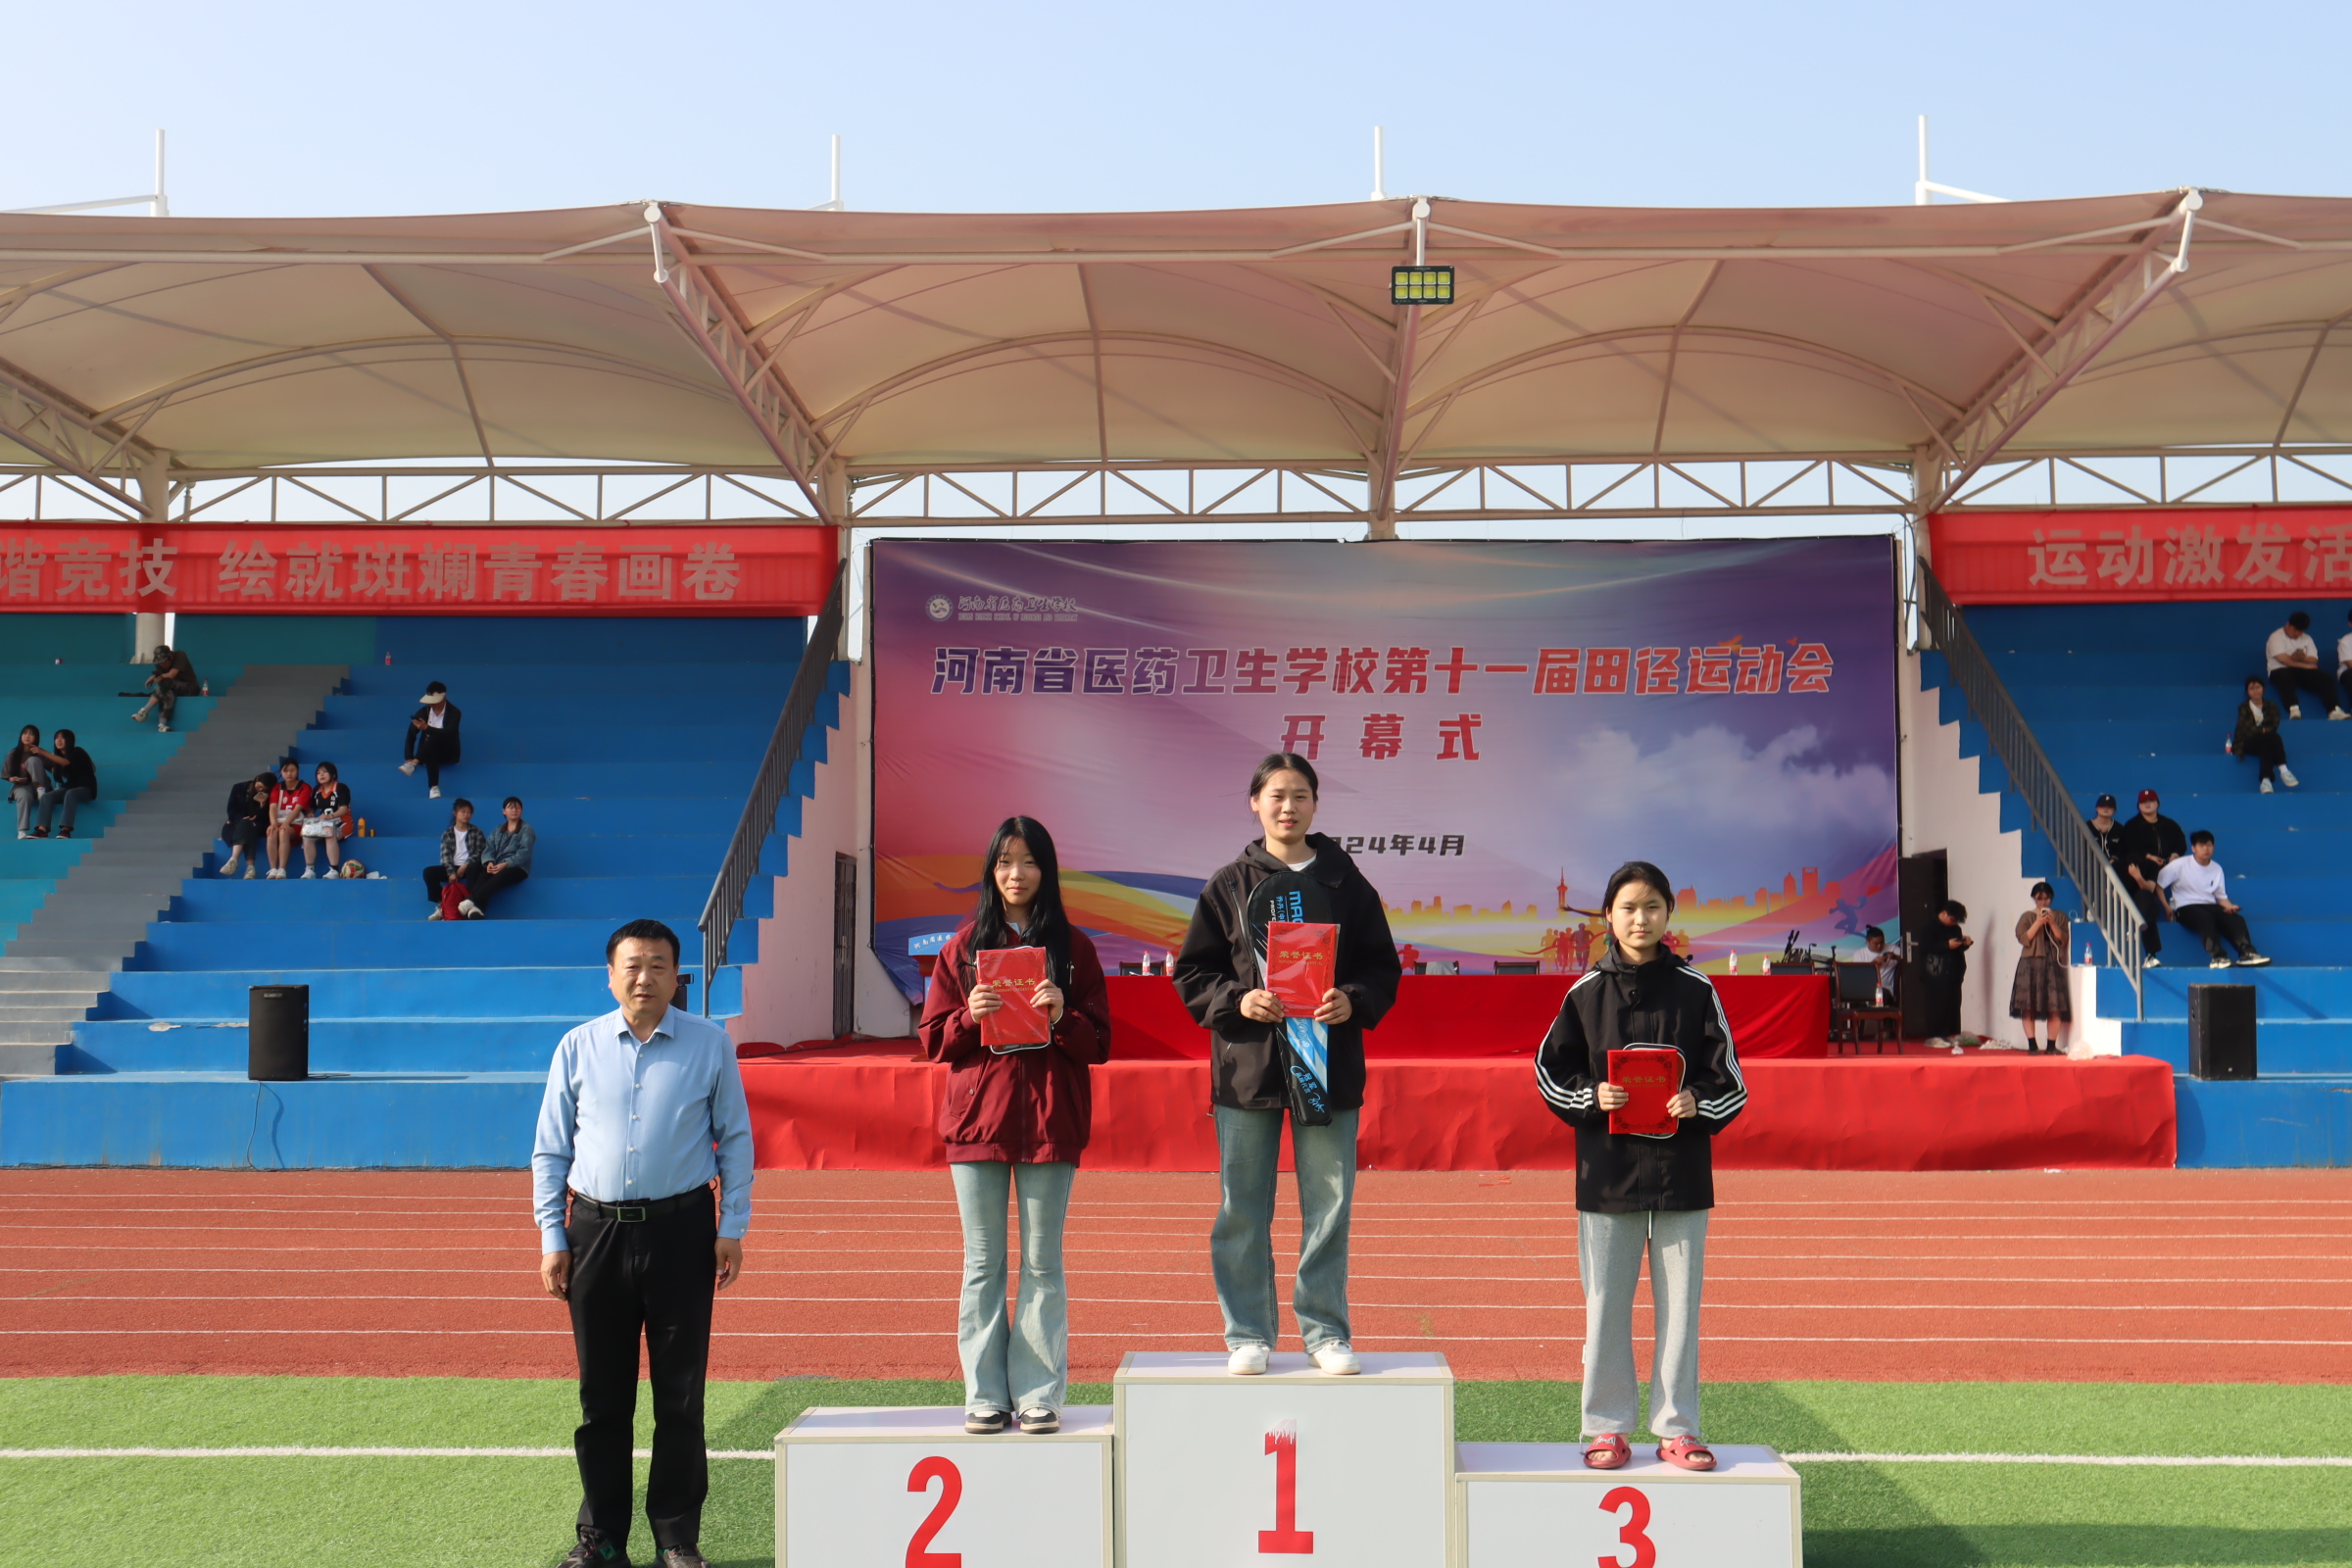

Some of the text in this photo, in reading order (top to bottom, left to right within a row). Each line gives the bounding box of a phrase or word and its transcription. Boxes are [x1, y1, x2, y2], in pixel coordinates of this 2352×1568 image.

[217, 539, 741, 601] 绘就斑斓青春画卷
[2028, 522, 2352, 586] 运动激发活
[957, 595, 1078, 613] 河南省医药卫生学校
[930, 643, 1834, 697] 河南省医药卫生学校第十一届田径运动会
[1280, 713, 1483, 761] 开幕式
[1279, 950, 1324, 960] 荣誉证书
[992, 977, 1036, 988] 荣誉证书
[1622, 1075, 1666, 1084] 荣誉证书
[905, 1456, 962, 1568] 2
[1258, 1419, 1314, 1554] 1
[1597, 1486, 1656, 1568] 3
